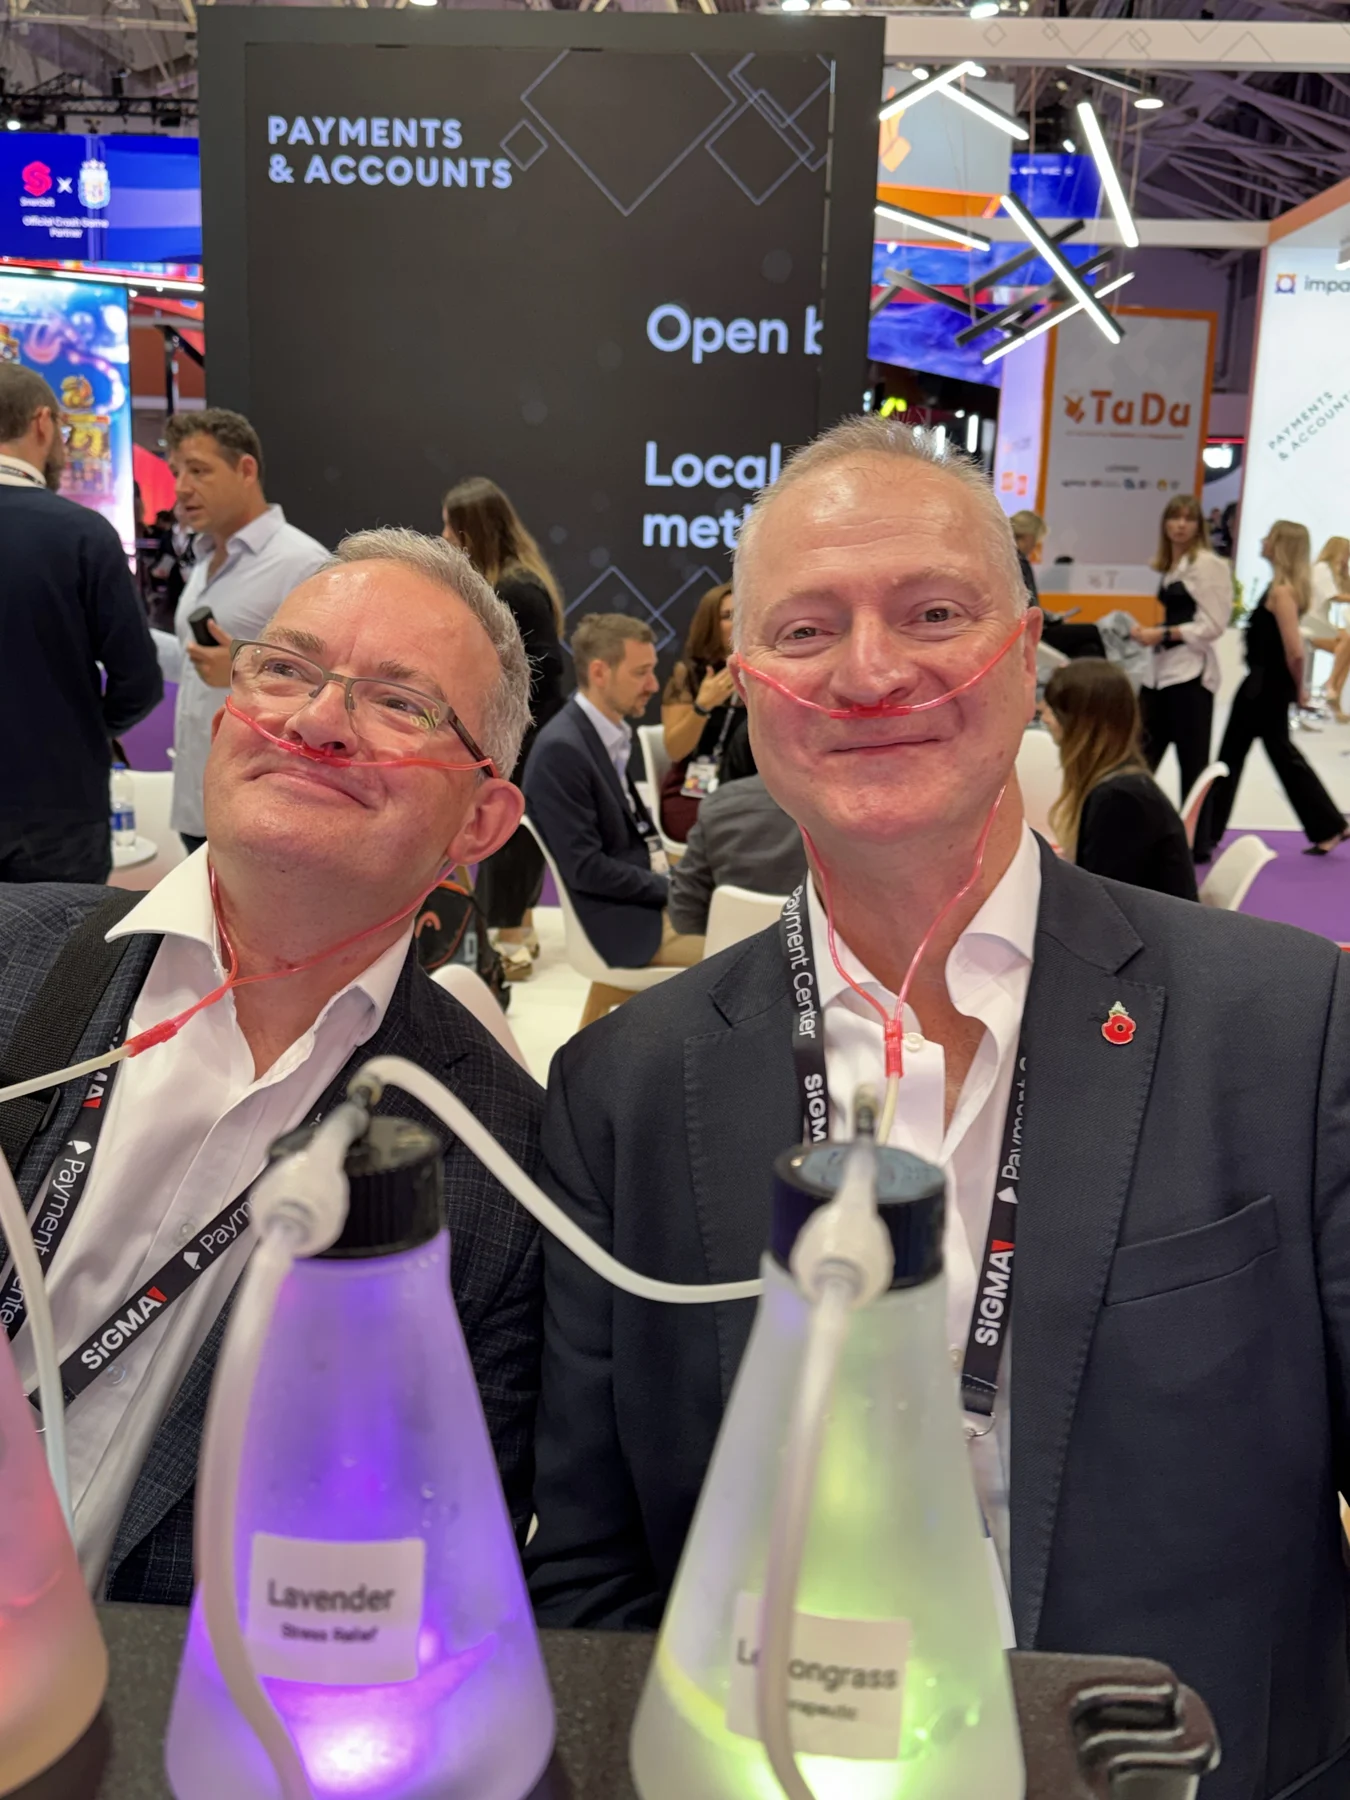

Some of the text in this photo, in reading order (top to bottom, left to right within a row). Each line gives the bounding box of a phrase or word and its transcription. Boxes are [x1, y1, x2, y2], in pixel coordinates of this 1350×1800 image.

[268, 115, 463, 149] PAYMENTS
[268, 153, 513, 190] & ACCOUNTS
[647, 304, 789, 364] Open
[1090, 389, 1191, 428] TaDa
[1268, 390, 1333, 450] PAYMENTS
[1291, 390, 1350, 451] ACCOUNT
[645, 441, 782, 489] Local
[643, 504, 754, 549] met
[793, 972, 817, 1039] Center
[33, 1158, 86, 1256] Payment
[975, 1240, 1015, 1347] SiGMA
[81, 1286, 167, 1370] SiGMA
[268, 1578, 395, 1613] Lavender
